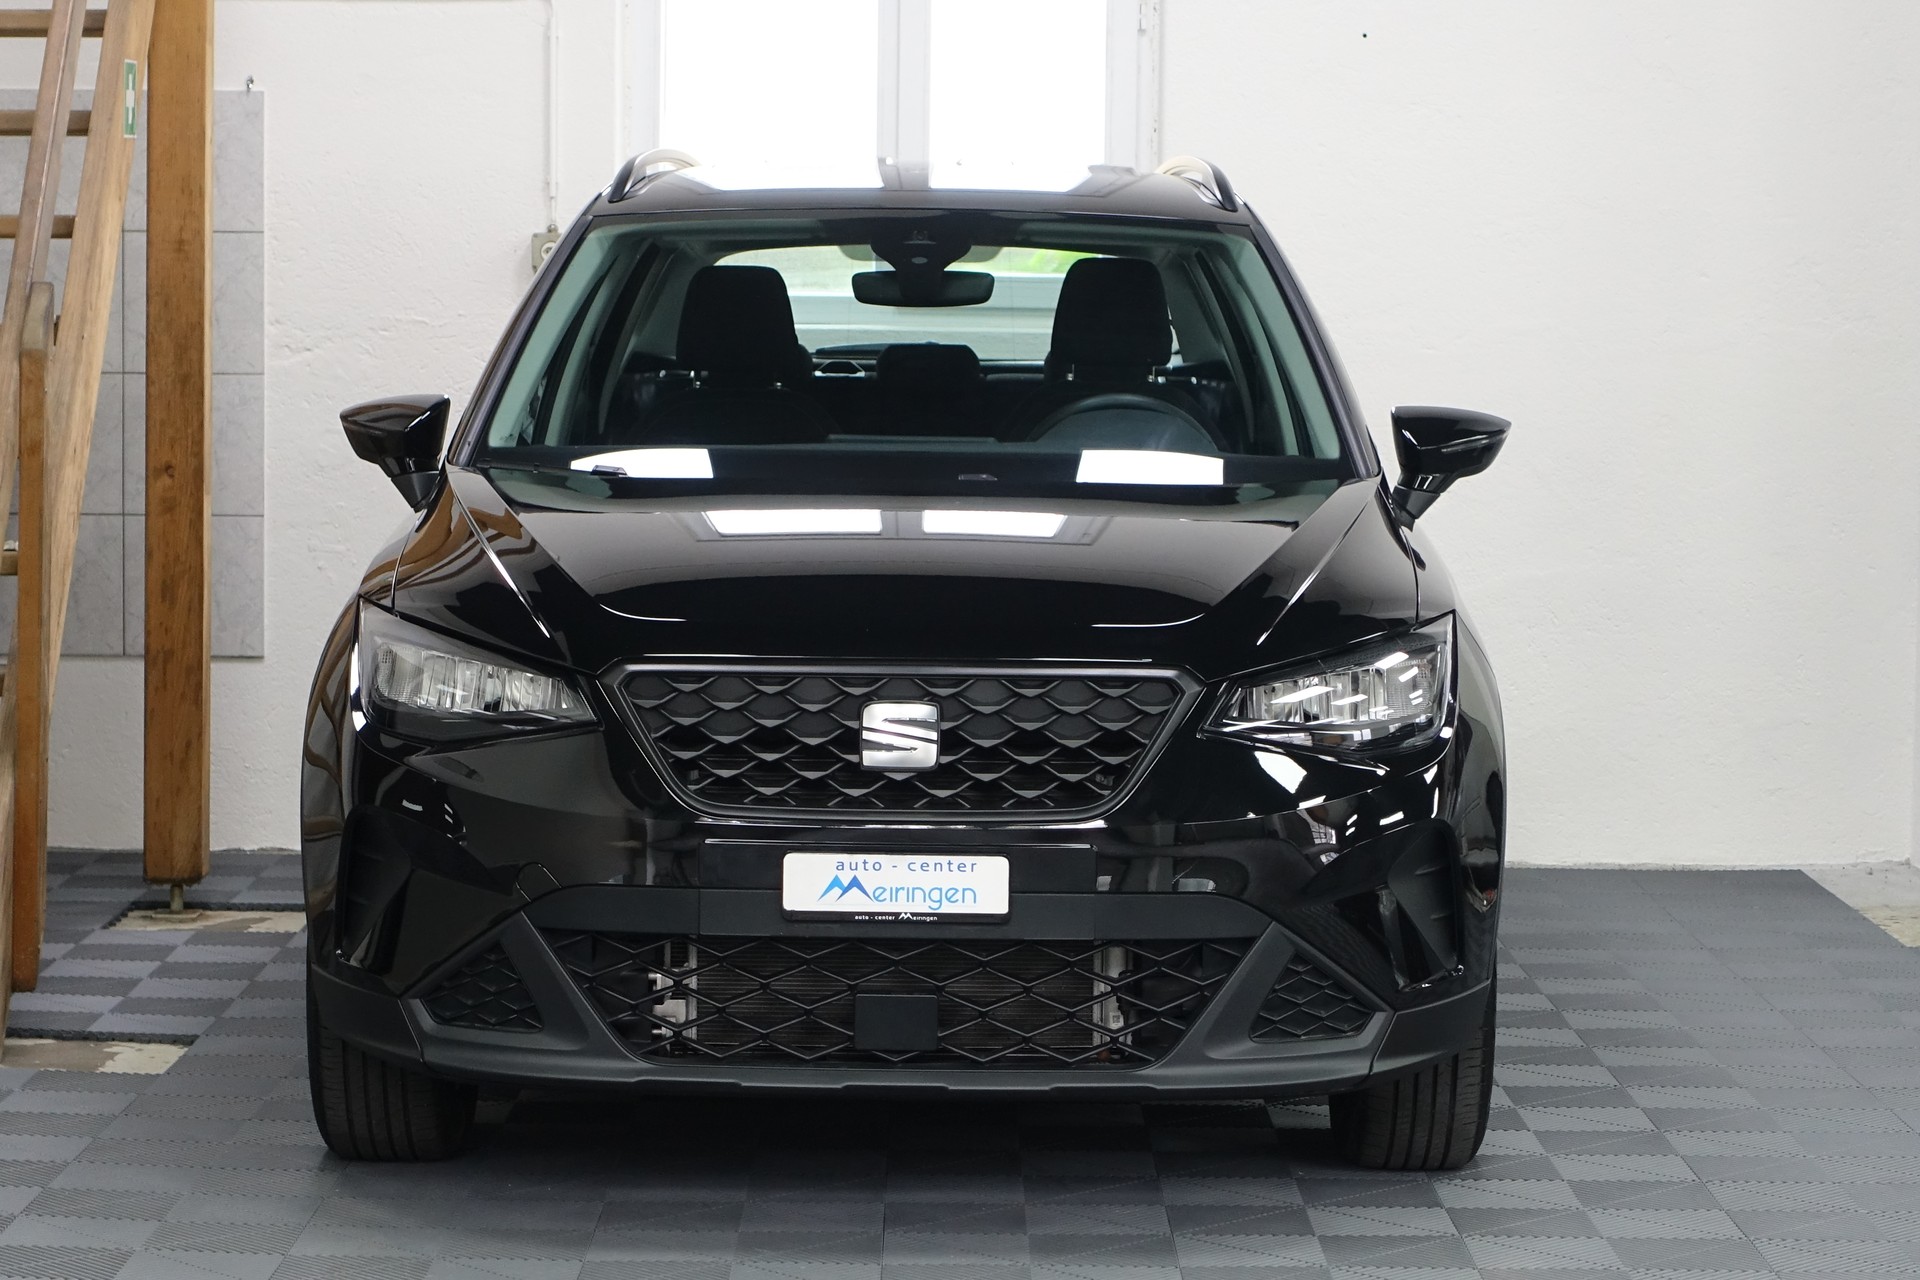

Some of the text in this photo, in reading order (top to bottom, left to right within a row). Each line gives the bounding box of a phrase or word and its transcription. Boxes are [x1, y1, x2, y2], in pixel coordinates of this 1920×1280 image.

[835, 858, 882, 872] auto
[907, 860, 978, 873] center
[817, 874, 977, 911] Meiringen
